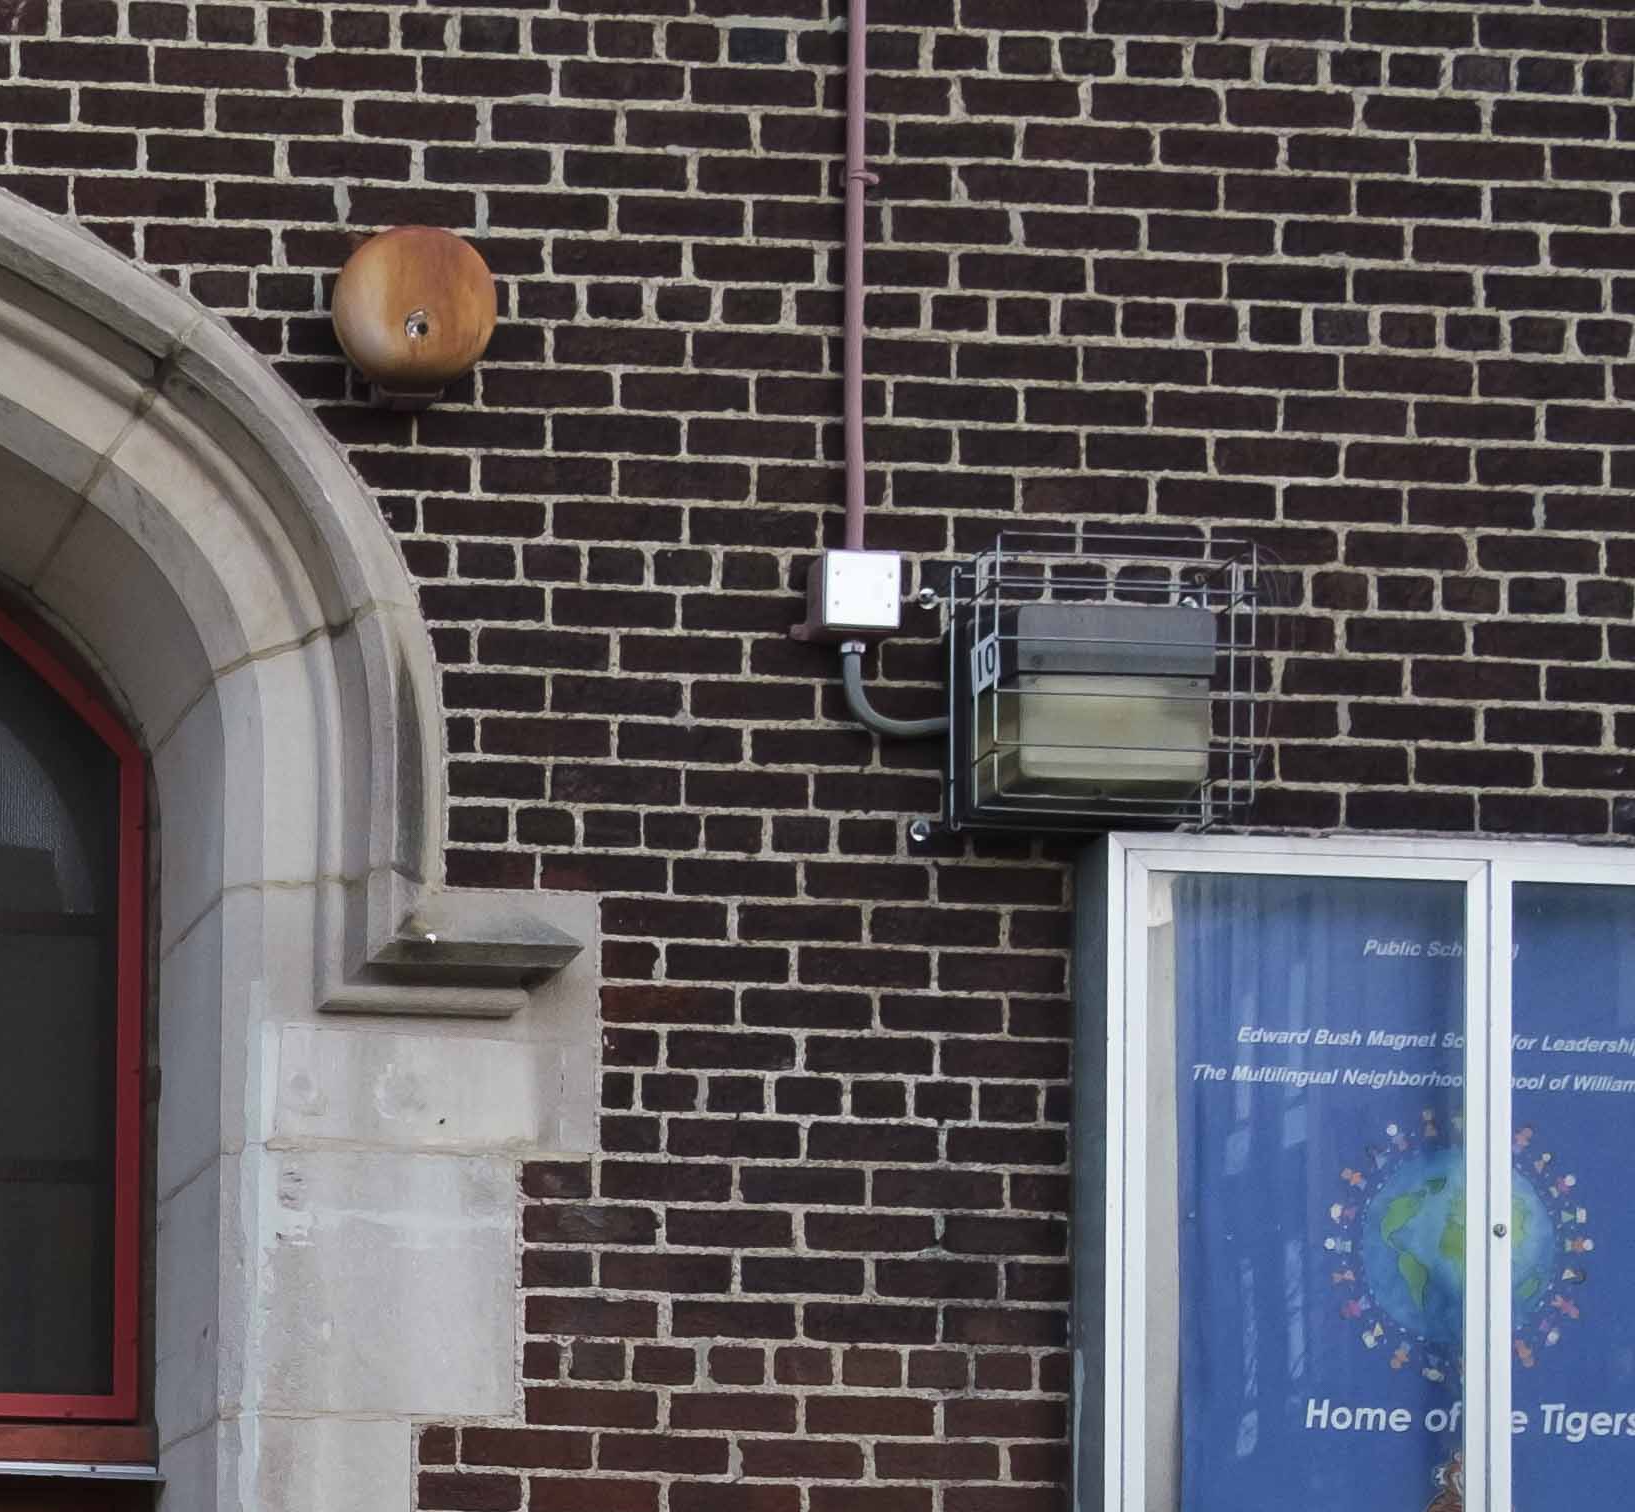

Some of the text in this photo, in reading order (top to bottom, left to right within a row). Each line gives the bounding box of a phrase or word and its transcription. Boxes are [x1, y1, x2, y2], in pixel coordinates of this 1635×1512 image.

[1363, 938, 1421, 957] Public
[1237, 1026, 1311, 1044] Edward
[1314, 1028, 1361, 1047] Bush
[1366, 1030, 1437, 1051] Magnet
[1192, 1063, 1466, 1090] The Multilingual Neighborhoo
[1549, 1073, 1571, 1091] of
[1305, 1397, 1463, 1433] Home of
